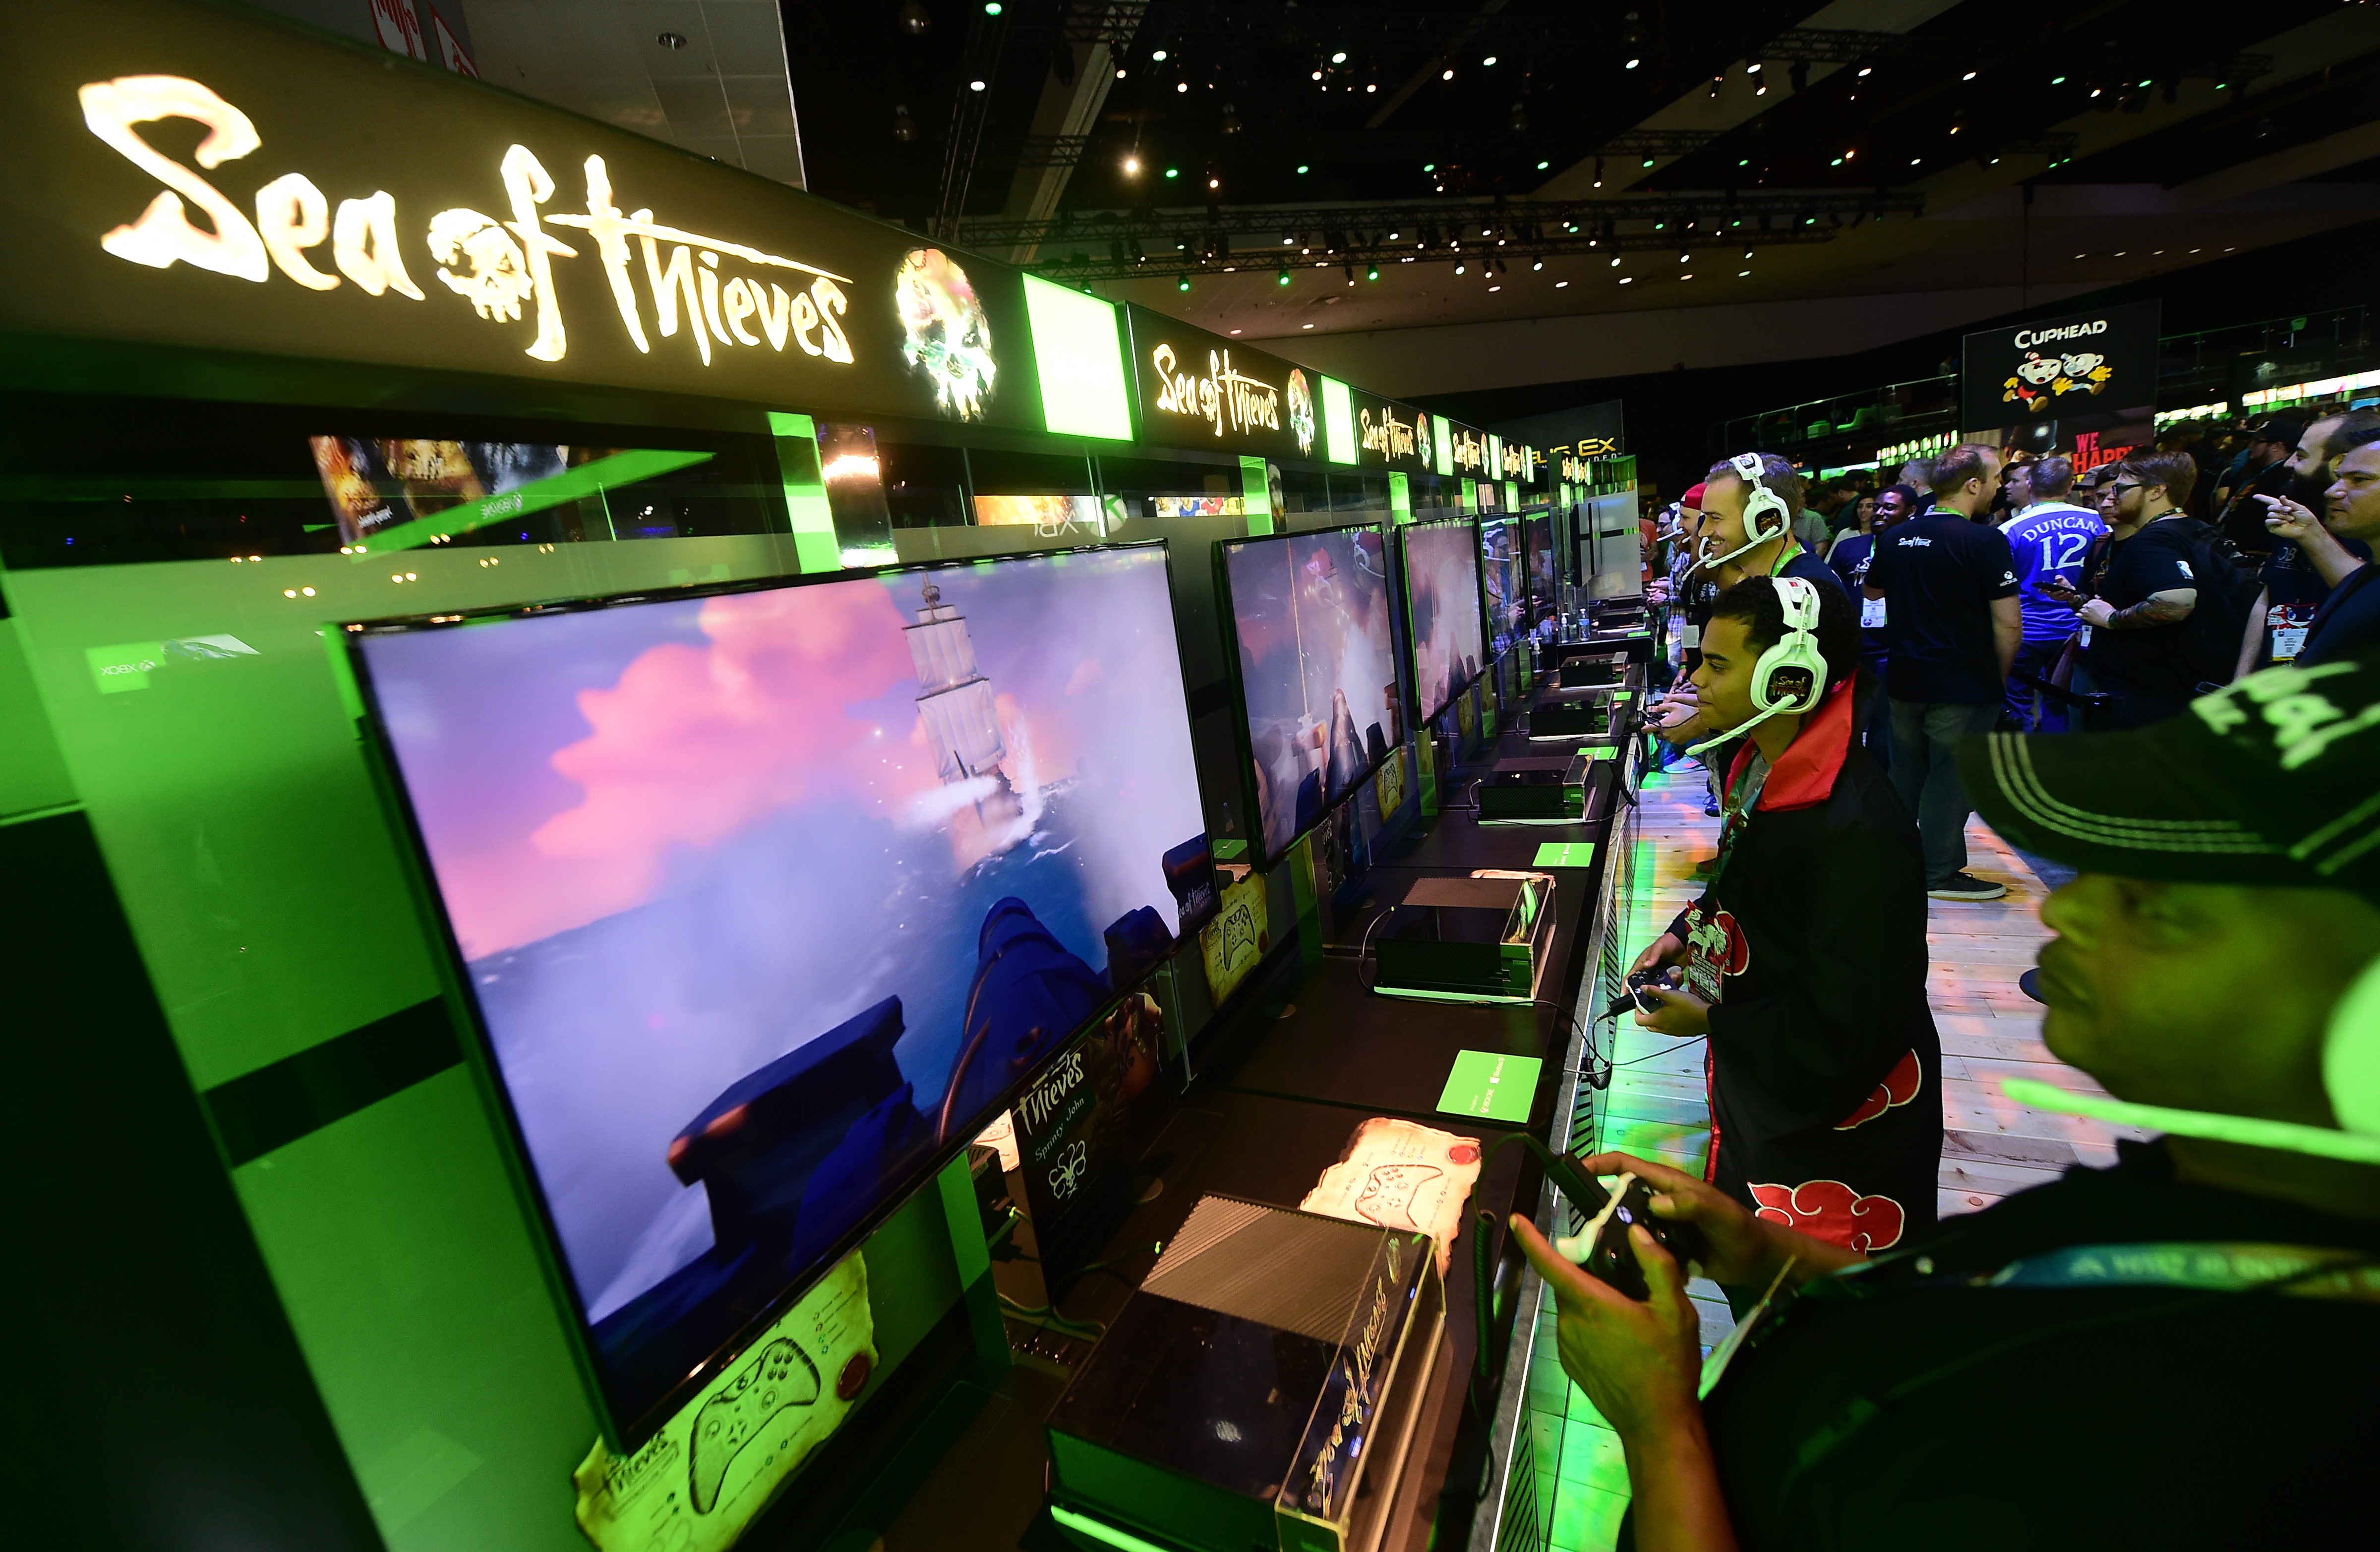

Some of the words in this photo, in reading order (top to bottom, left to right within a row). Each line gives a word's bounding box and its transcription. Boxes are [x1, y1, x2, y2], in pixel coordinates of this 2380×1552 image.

[78, 73, 425, 300] Sea
[427, 144, 578, 362] of
[543, 154, 855, 367] Thieves
[1153, 343, 1200, 416] Sea
[1199, 349, 1224, 437] of
[1217, 348, 1280, 436] Thieves
[1360, 408, 1380, 451] Sea
[2076, 431, 2099, 453] WE
[2072, 443, 2144, 475] HAPP
[2021, 517, 2098, 542] DUNCAN
[2039, 532, 2085, 572] 12
[1035, 1123, 1063, 1161] Sprinty
[1066, 1098, 1084, 1121] John
